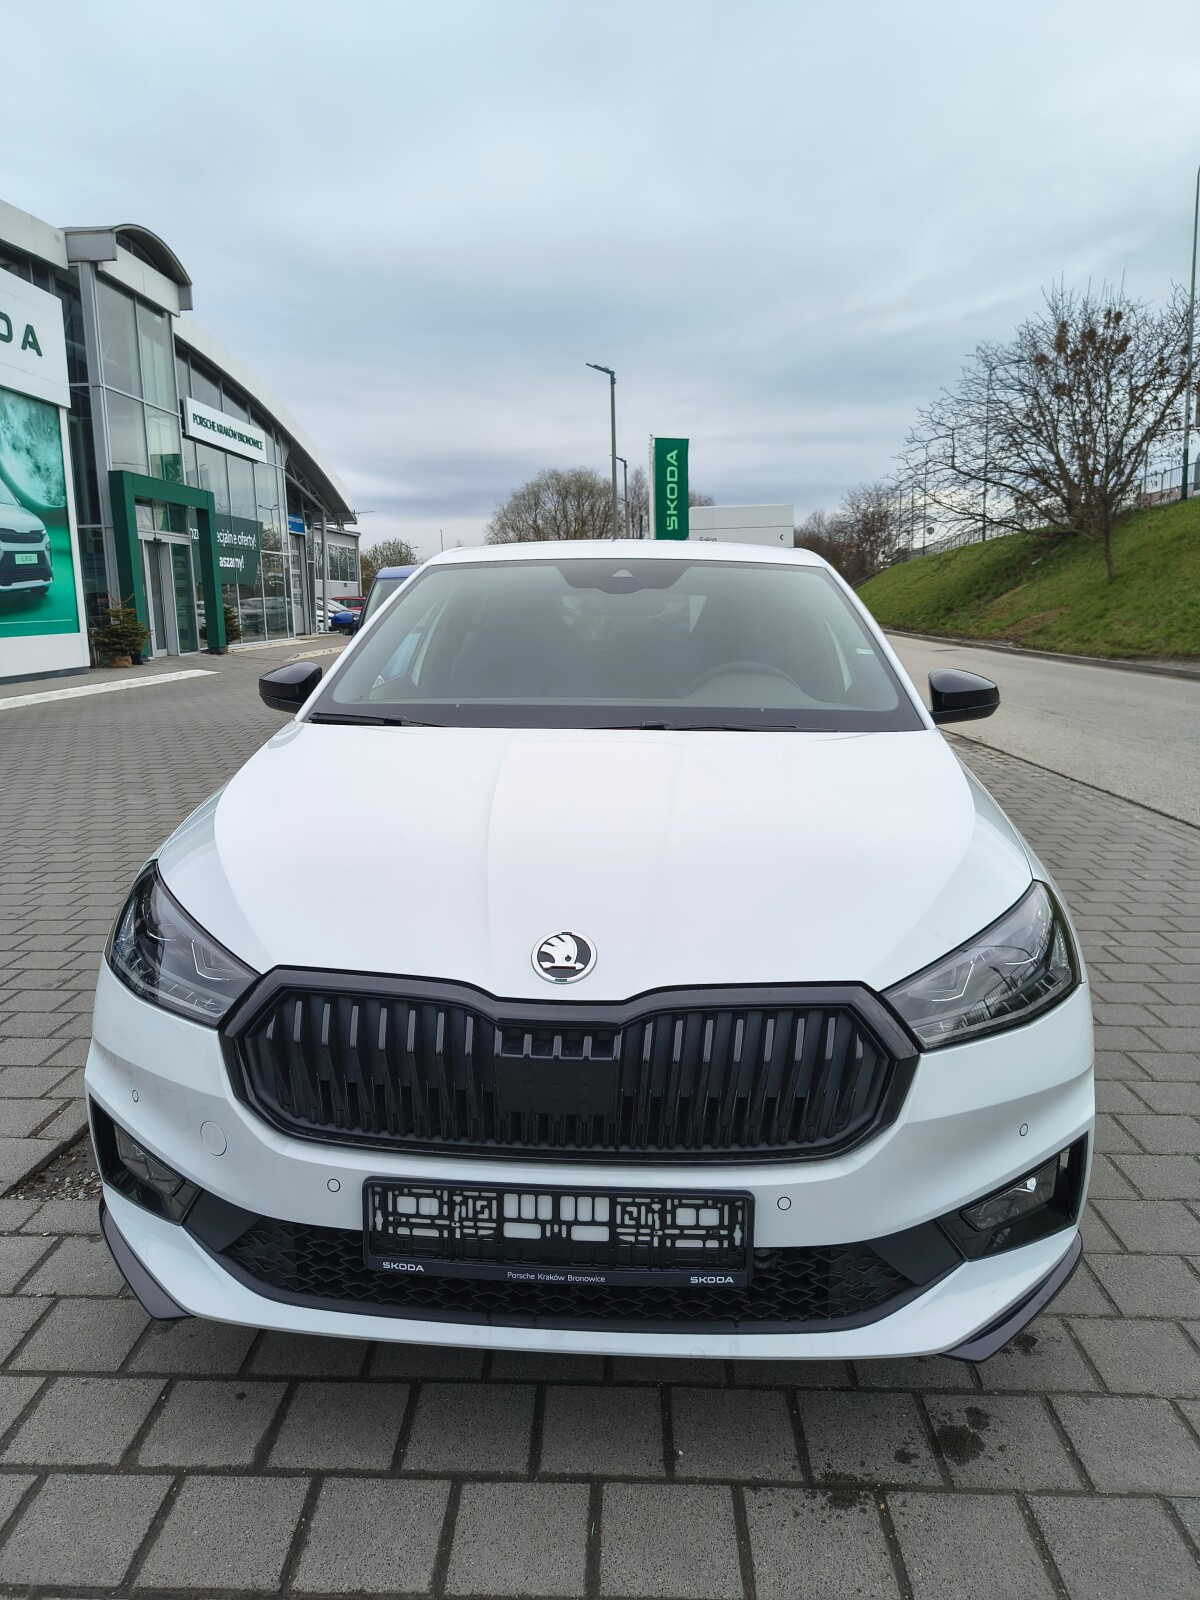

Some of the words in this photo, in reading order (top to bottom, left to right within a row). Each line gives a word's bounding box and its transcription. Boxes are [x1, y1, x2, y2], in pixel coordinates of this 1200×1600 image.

[192, 413, 217, 432] PORSCHE
[217, 424, 238, 440] KRAKÓW
[237, 432, 264, 451] BRONOWICE
[507, 1271, 536, 1280] Porsche
[537, 1272, 566, 1281] Kraków
[567, 1274, 606, 1283] Bronowice
